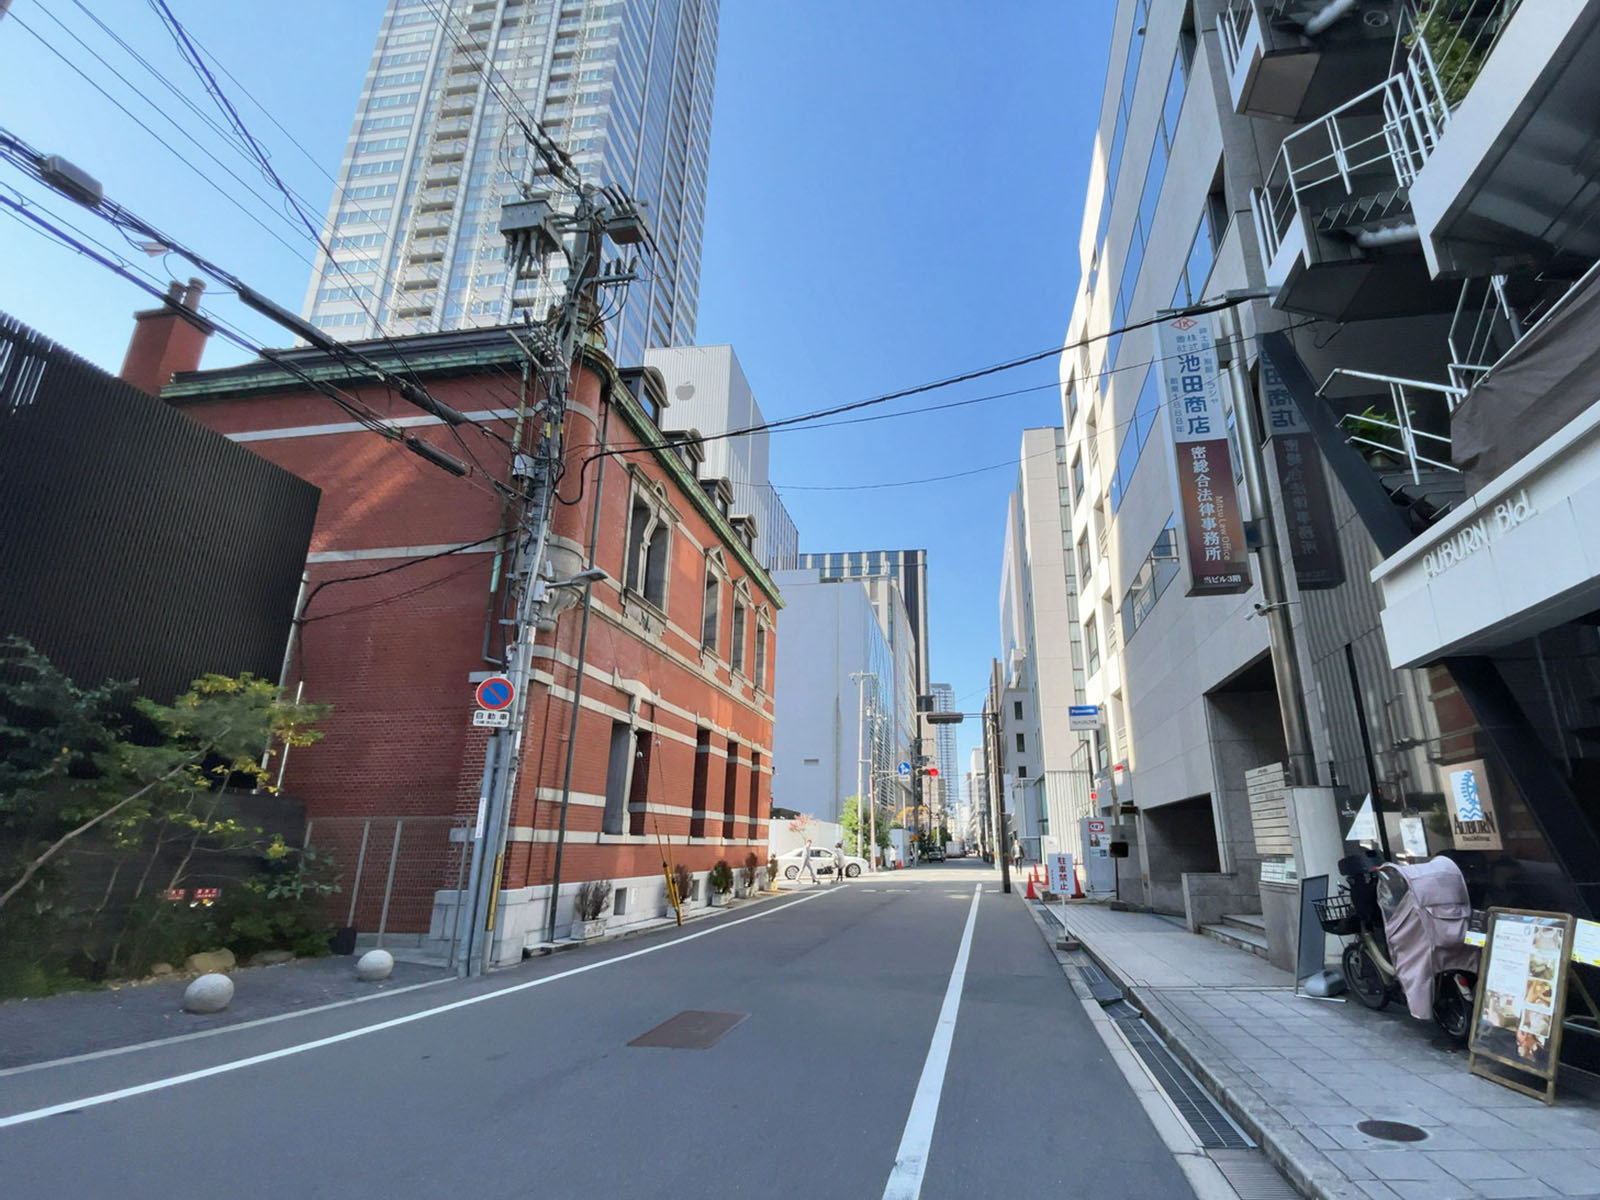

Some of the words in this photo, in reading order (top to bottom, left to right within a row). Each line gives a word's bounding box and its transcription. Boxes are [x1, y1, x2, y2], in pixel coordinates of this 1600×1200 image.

[1178, 355, 1210, 435] 池田商店
[1191, 445, 1222, 561] 密総合法律事務所
[1221, 536, 1232, 561] Office
[1422, 518, 1491, 579] AUBURN
